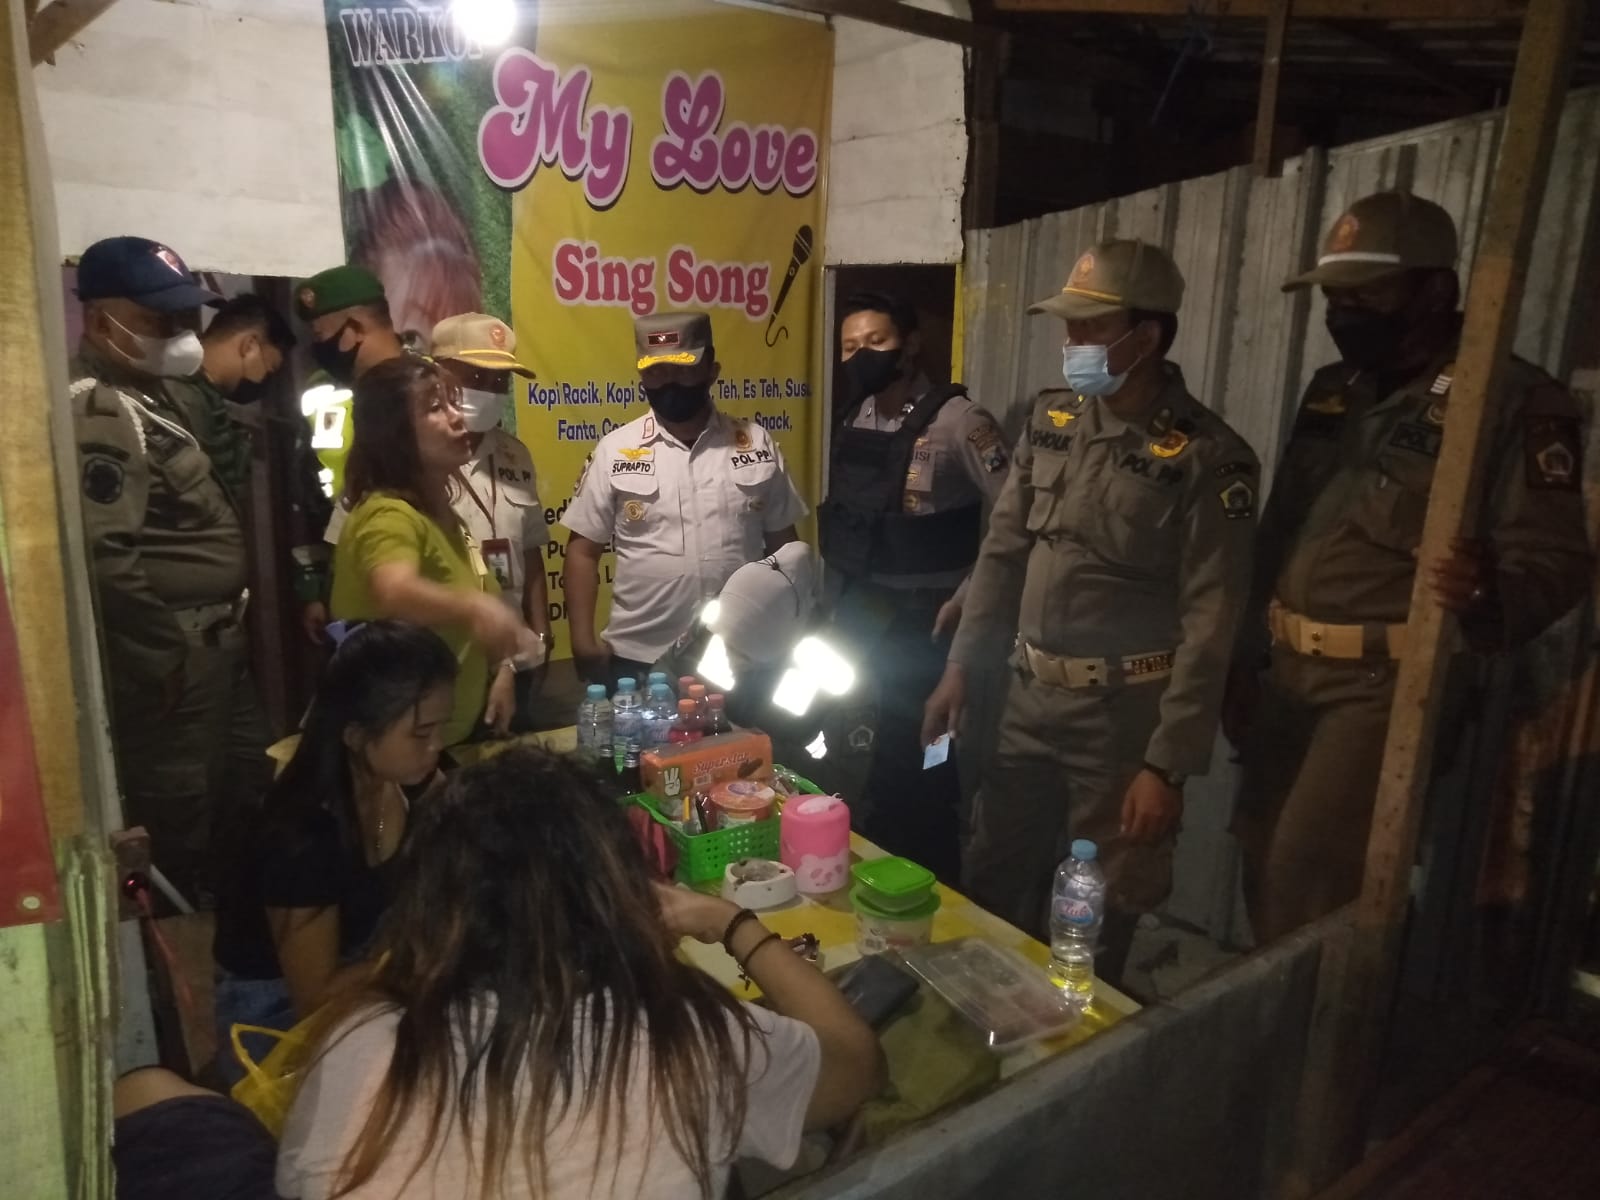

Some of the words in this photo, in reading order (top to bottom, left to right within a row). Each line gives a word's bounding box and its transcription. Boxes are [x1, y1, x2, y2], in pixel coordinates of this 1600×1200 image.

[339, 7, 482, 66] WARKO
[478, 47, 633, 209] My
[649, 69, 818, 194] Love
[551, 238, 656, 317] Sing
[666, 242, 771, 321] Song
[527, 383, 561, 411] Kopi
[562, 382, 603, 408] Racik,
[606, 380, 635, 409] Kopi
[717, 379, 741, 400] Teh,
[743, 379, 757, 398] Es
[759, 378, 782, 399] Teh,
[557, 419, 600, 443] Fanta,
[612, 460, 651, 475] SUPRAPTO
[731, 454, 755, 467] POL
[756, 450, 772, 462] PP
